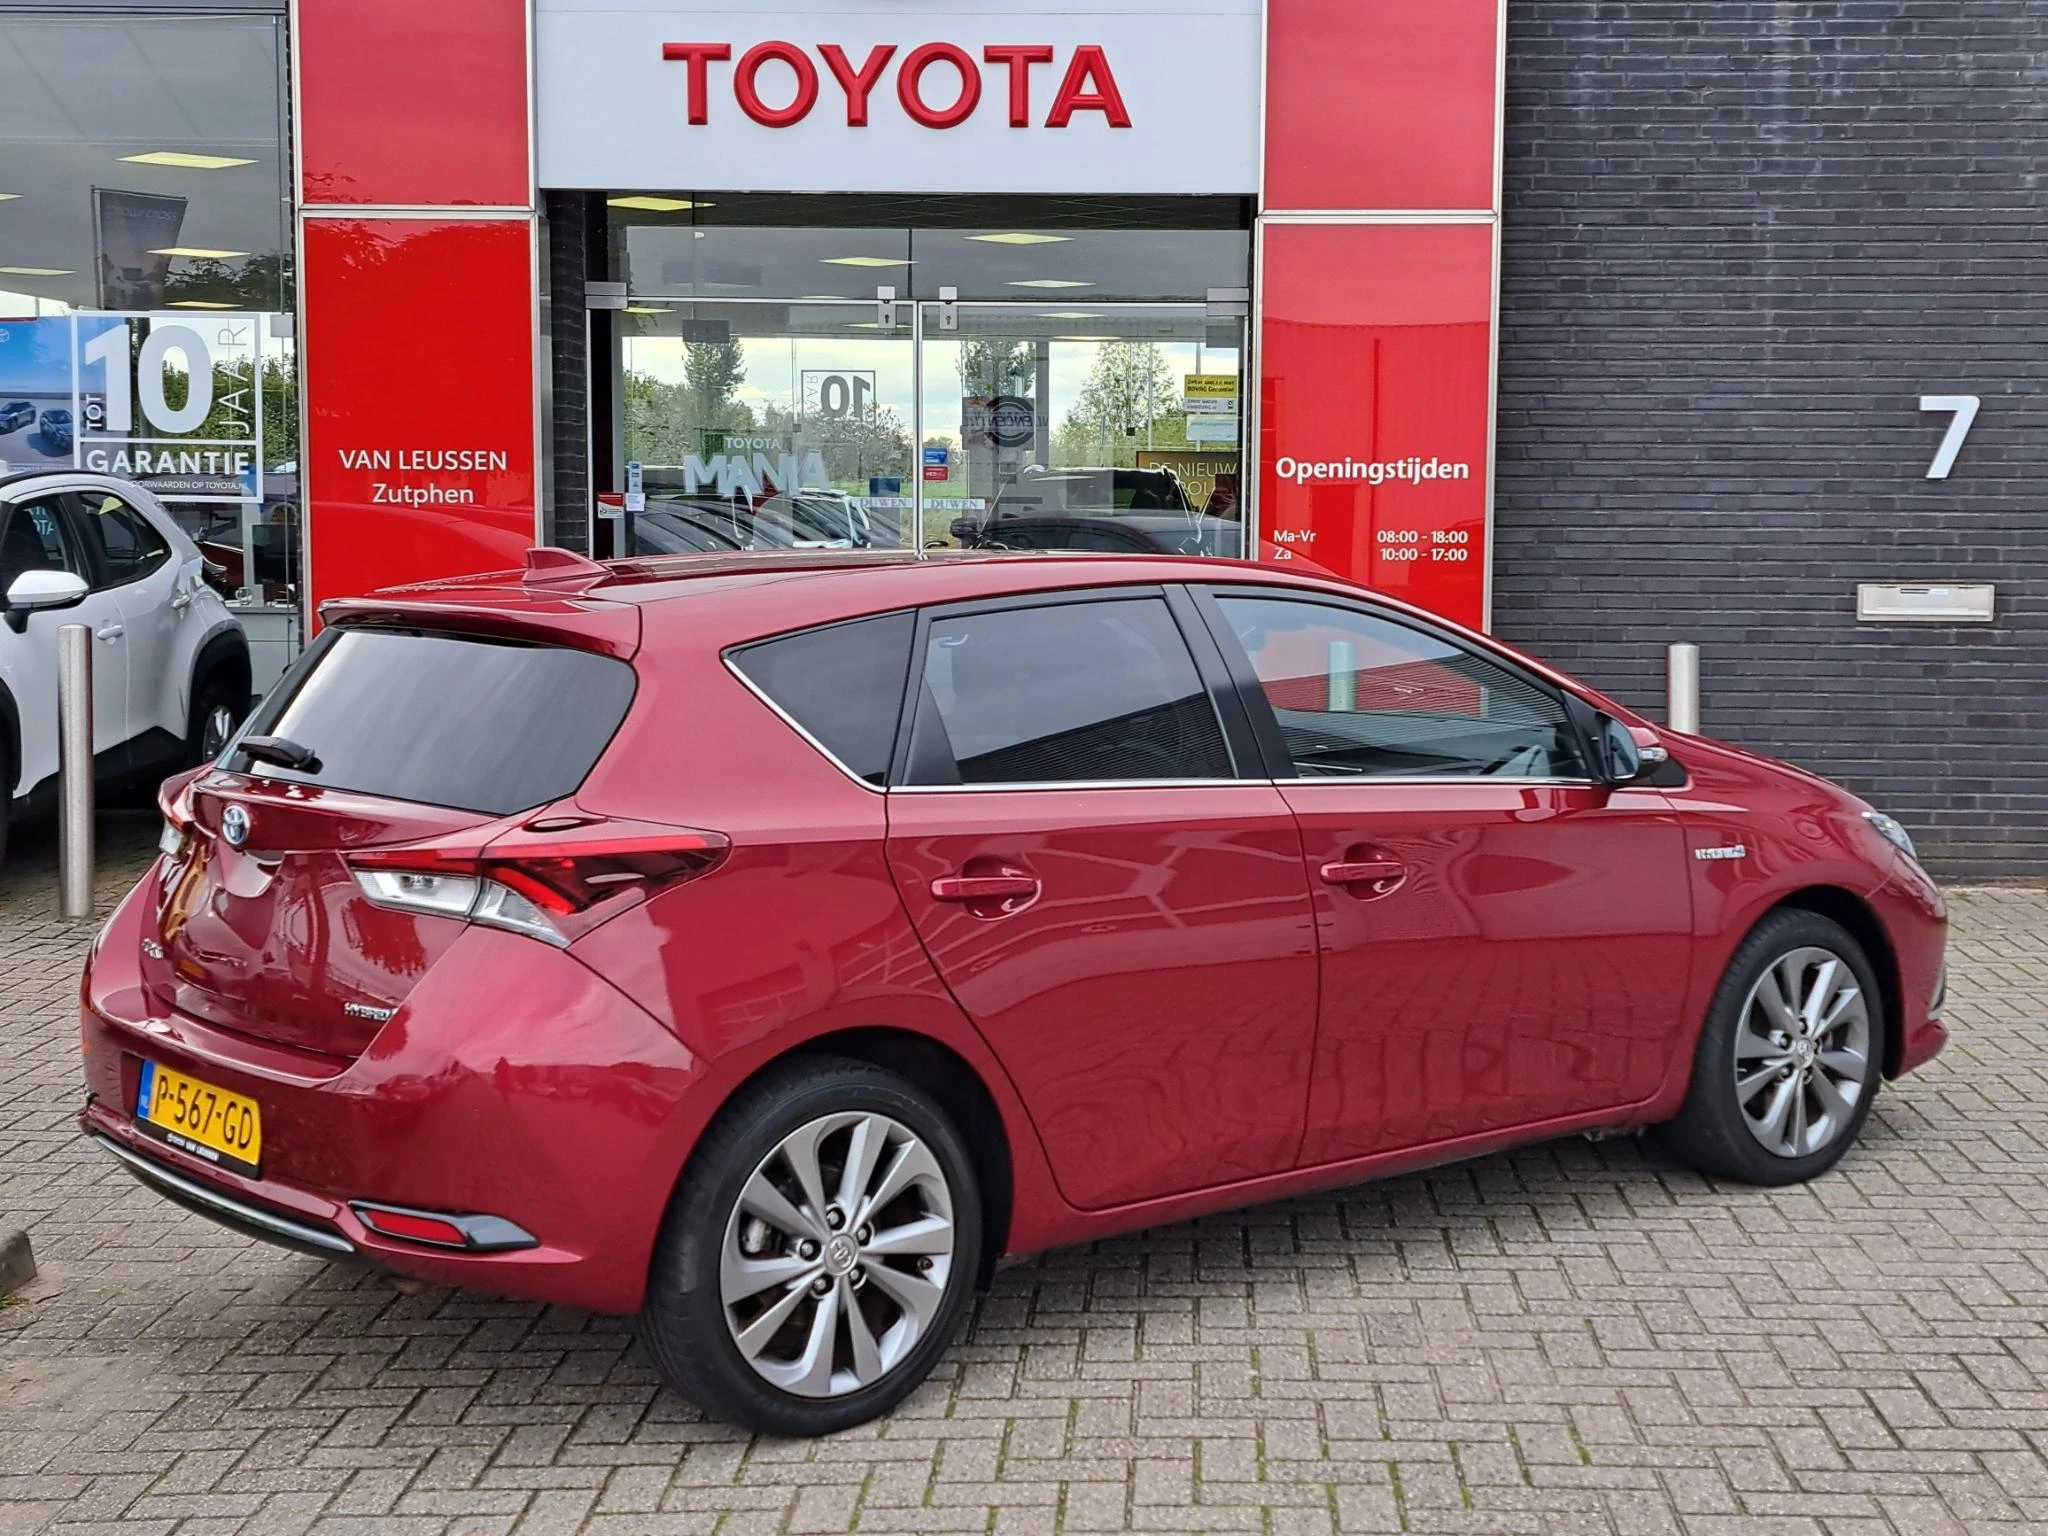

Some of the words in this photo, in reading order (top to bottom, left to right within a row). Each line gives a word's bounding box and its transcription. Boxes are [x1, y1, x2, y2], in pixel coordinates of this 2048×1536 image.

[662, 40, 1133, 130] TOYOTA
[84, 325, 213, 434] 10
[217, 327, 250, 434] JAAR
[86, 394, 103, 431] TOT
[725, 437, 782, 450] TOYOTA
[1920, 395, 1981, 479] 7
[86, 449, 250, 475] GARANTIE
[338, 449, 391, 470] VAN
[399, 450, 508, 471] LEUSSEN
[1275, 457, 1469, 485] Openingstijden
[191, 481, 204, 489] OP
[372, 482, 474, 509] Zutphen
[683, 452, 830, 512] MANIA
[1273, 529, 1317, 543] Ma-Vr
[1376, 530, 1418, 543] 08:00
[1431, 530, 1469, 543] 18:00
[1273, 547, 1292, 560] Za
[1380, 548, 1418, 561] 10:00
[1431, 548, 1469, 561] 17:00
[154, 1074, 253, 1150] P-567-GD
